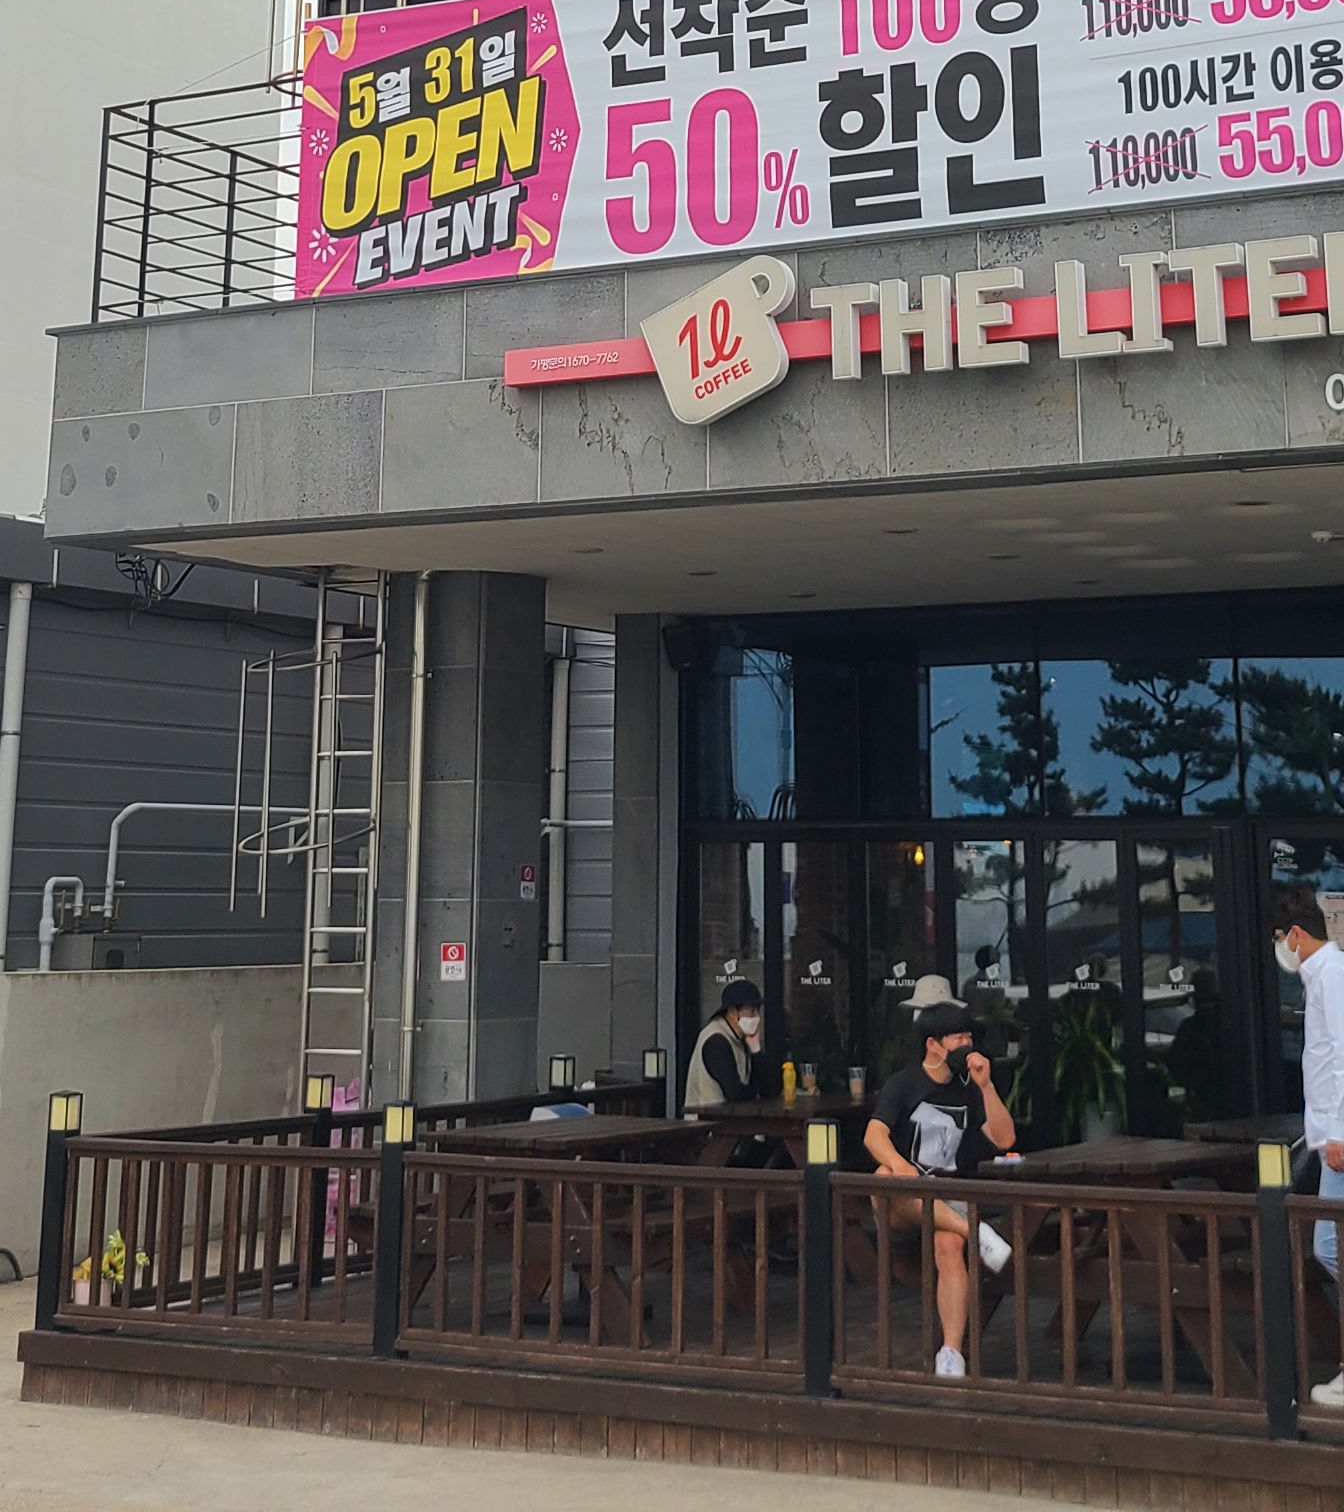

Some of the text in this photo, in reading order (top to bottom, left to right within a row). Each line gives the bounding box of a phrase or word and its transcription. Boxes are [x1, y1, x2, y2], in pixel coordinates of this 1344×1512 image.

[348, 30, 517, 130] 5월 31일
[1118, 50, 1259, 115] 100시간
[321, 77, 543, 232] OPEN
[604, 44, 1046, 256] 50% 할인
[1089, 127, 1199, 191] 110,000
[356, 185, 522, 288] EVENT
[810, 267, 1030, 382] THE
[694, 358, 753, 400] COFFEE
[800, 977, 831, 985] THE LITER
